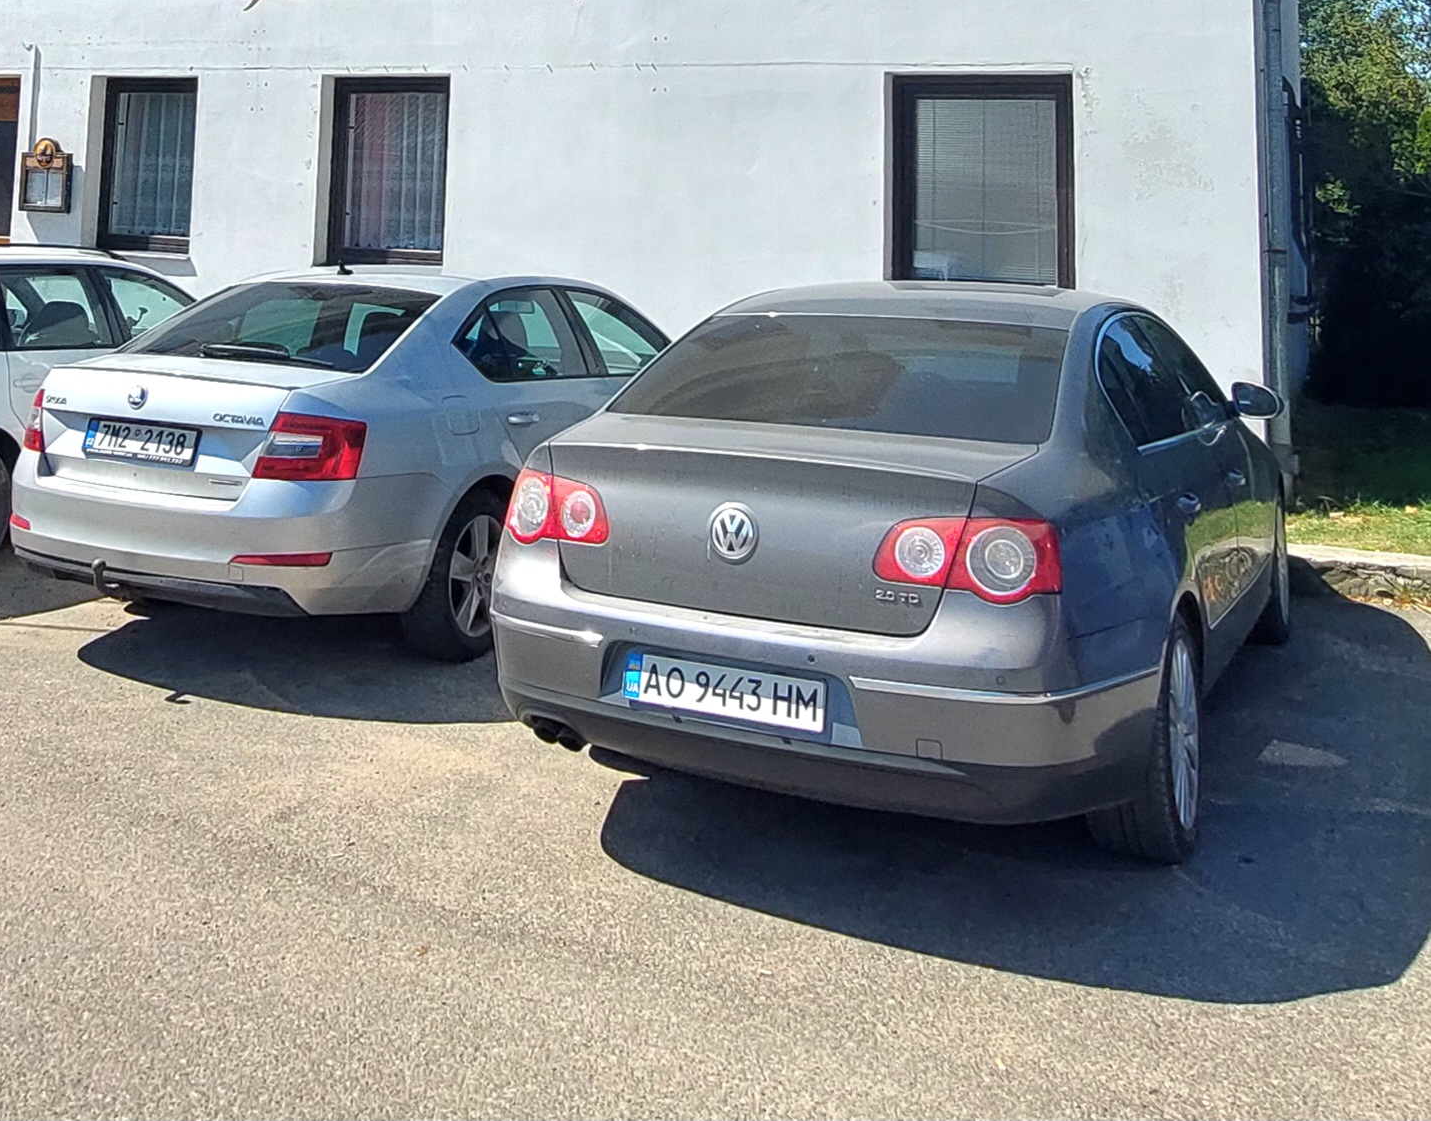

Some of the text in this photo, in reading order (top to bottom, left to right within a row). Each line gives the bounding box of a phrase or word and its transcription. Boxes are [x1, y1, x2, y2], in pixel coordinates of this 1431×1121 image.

[212, 412, 266, 427] OCTAVIA
[140, 427, 187, 456] 2138
[626, 683, 638, 693] UA
[643, 663, 818, 722] AO 9443 HM
